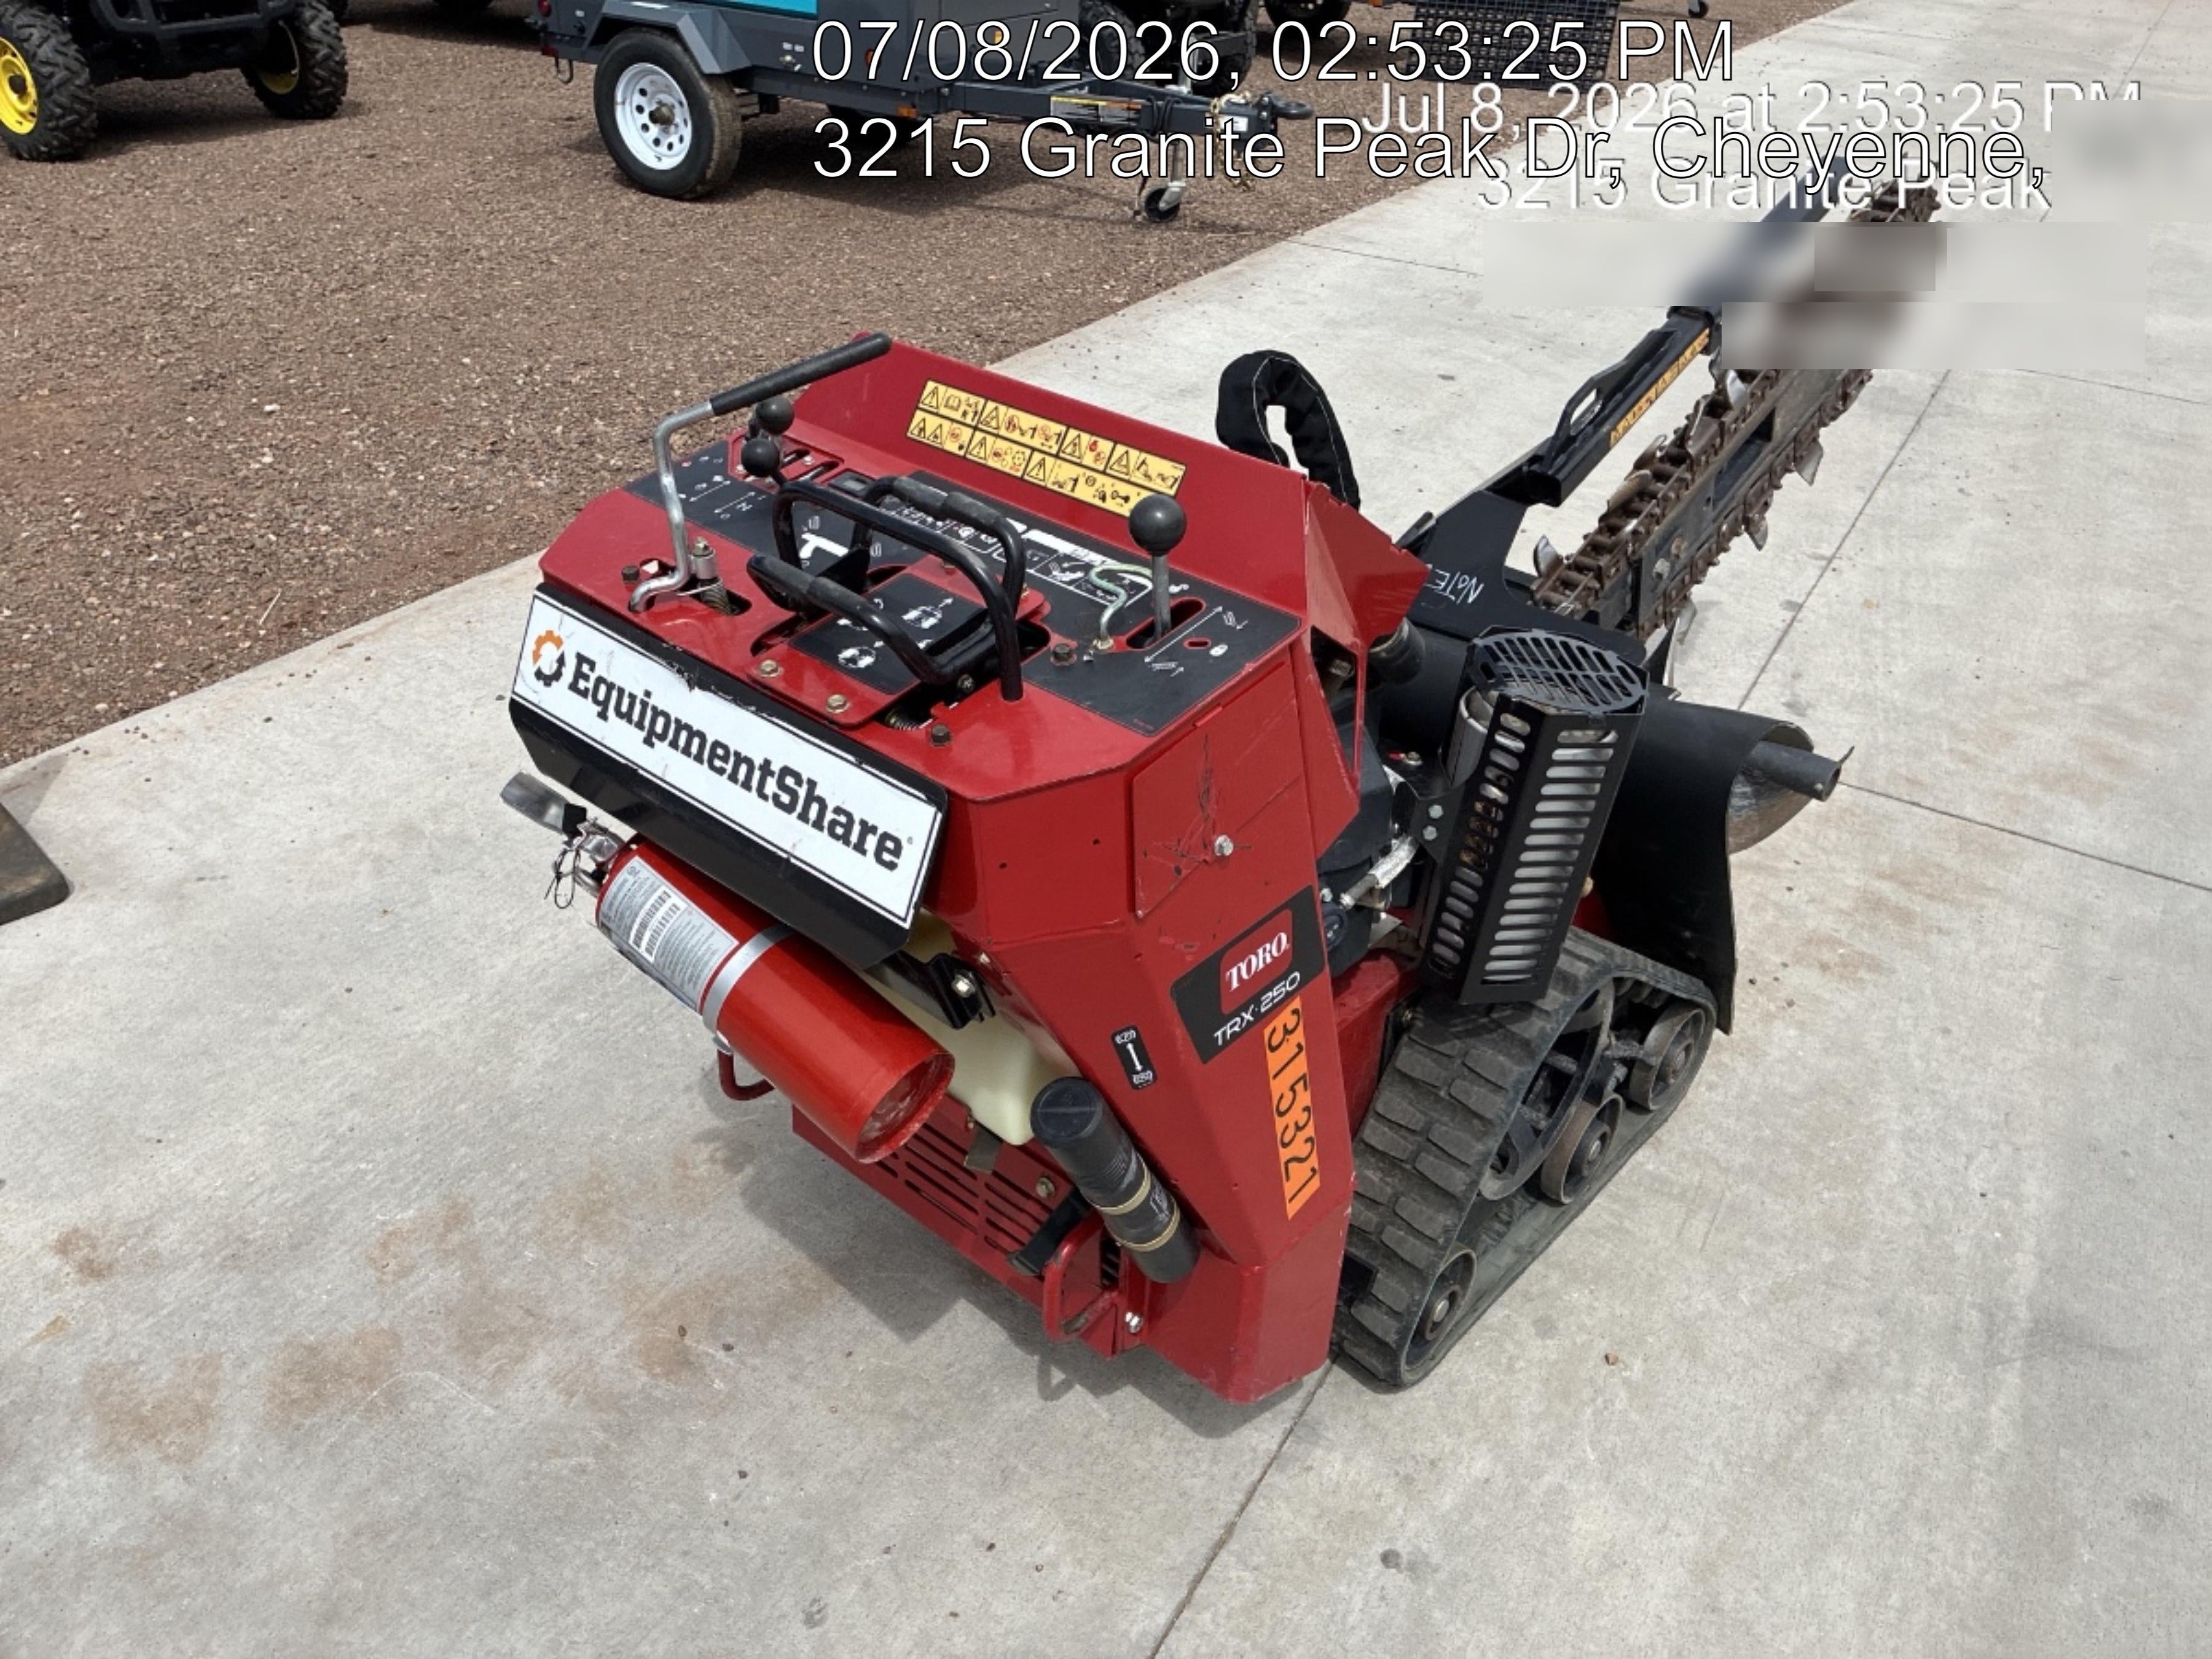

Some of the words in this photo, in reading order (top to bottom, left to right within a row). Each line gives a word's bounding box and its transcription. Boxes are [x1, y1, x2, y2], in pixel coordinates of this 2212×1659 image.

[568, 652, 903, 871] EquipmentShare
[1225, 931, 1289, 992] TORO
[1267, 1007, 1317, 1204] 315321
